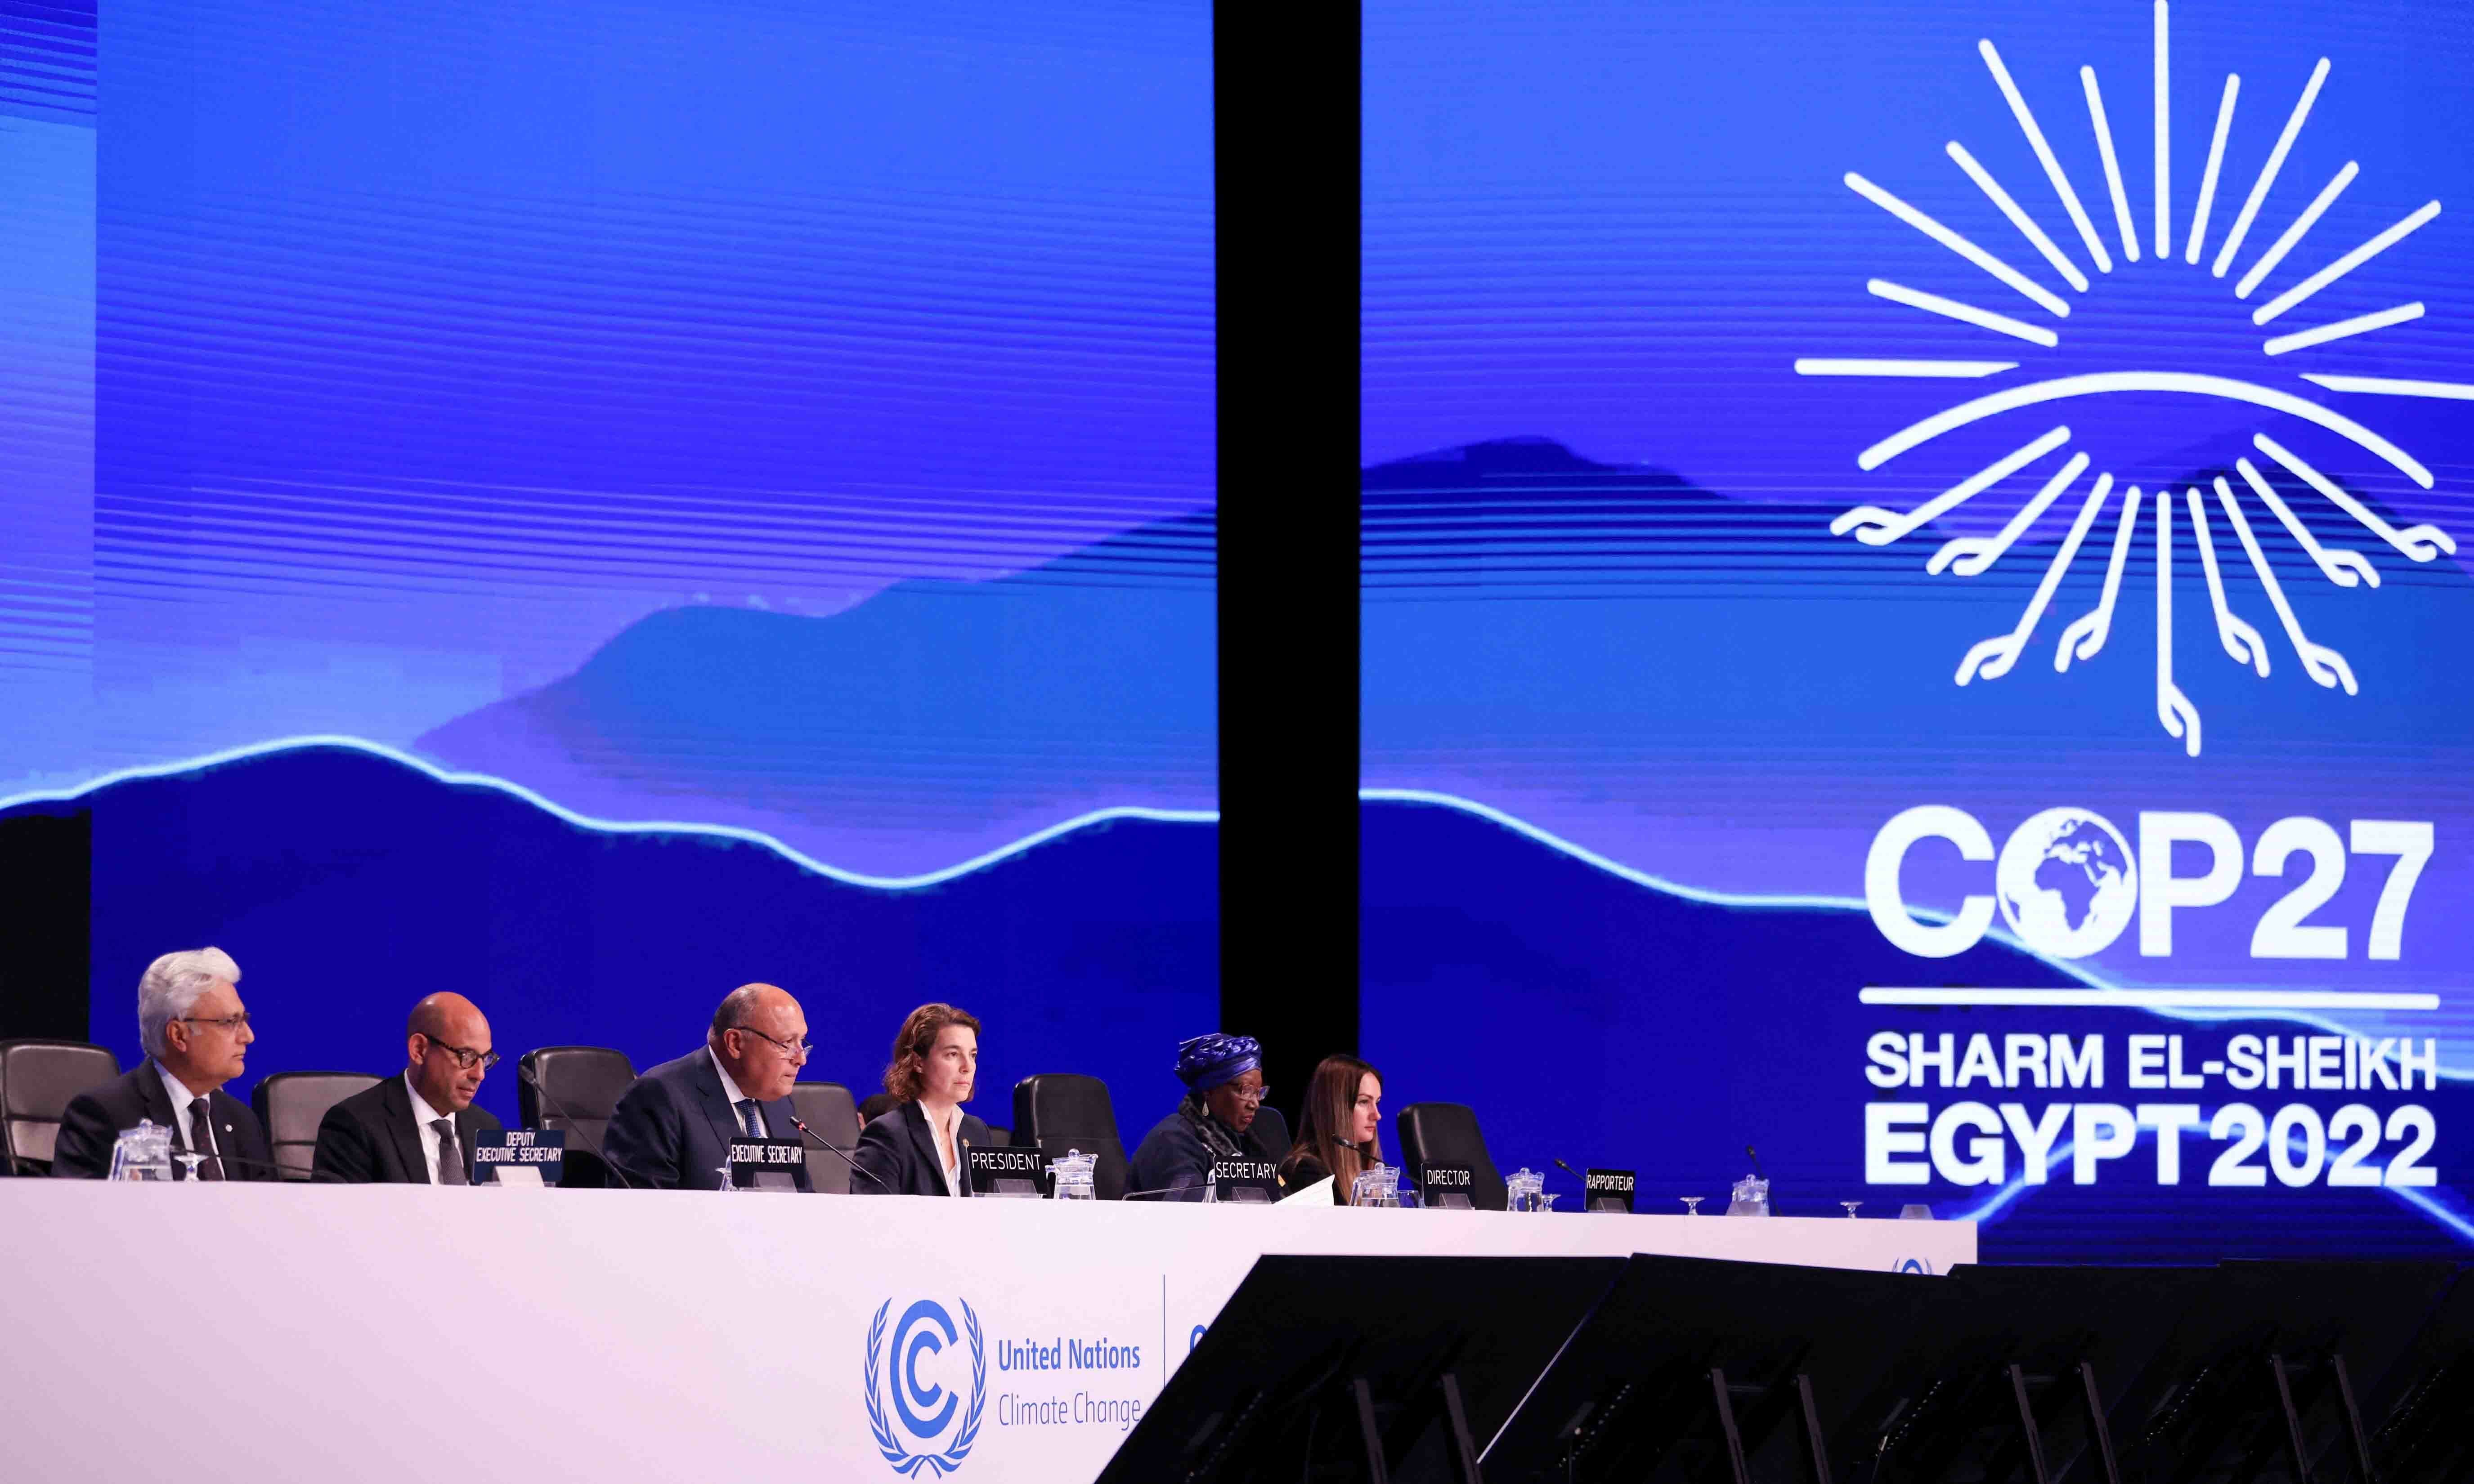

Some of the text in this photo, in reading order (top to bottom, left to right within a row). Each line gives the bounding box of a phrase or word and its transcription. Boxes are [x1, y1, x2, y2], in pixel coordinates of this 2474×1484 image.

[1864, 805, 2434, 960] COP27
[1865, 1033, 2436, 1090] SHARM EL-SHEIKH
[506, 1131, 536, 1146] DEPUTY
[1865, 1102, 2437, 1187] EGYPT 2022
[476, 1147, 562, 1162] EXECUTIVE SECRETARY
[731, 1144, 802, 1164] EXECUTIVE SECRETARY
[971, 1153, 1040, 1170] PRESIDENT
[1216, 1162, 1277, 1179] SECRETARY
[1427, 1170, 1470, 1185] DIRECTOR
[1587, 1174, 1634, 1191] RAPPORTEUR
[999, 1337, 1140, 1371] United Nations
[999, 1391, 1140, 1431] Climate Change
